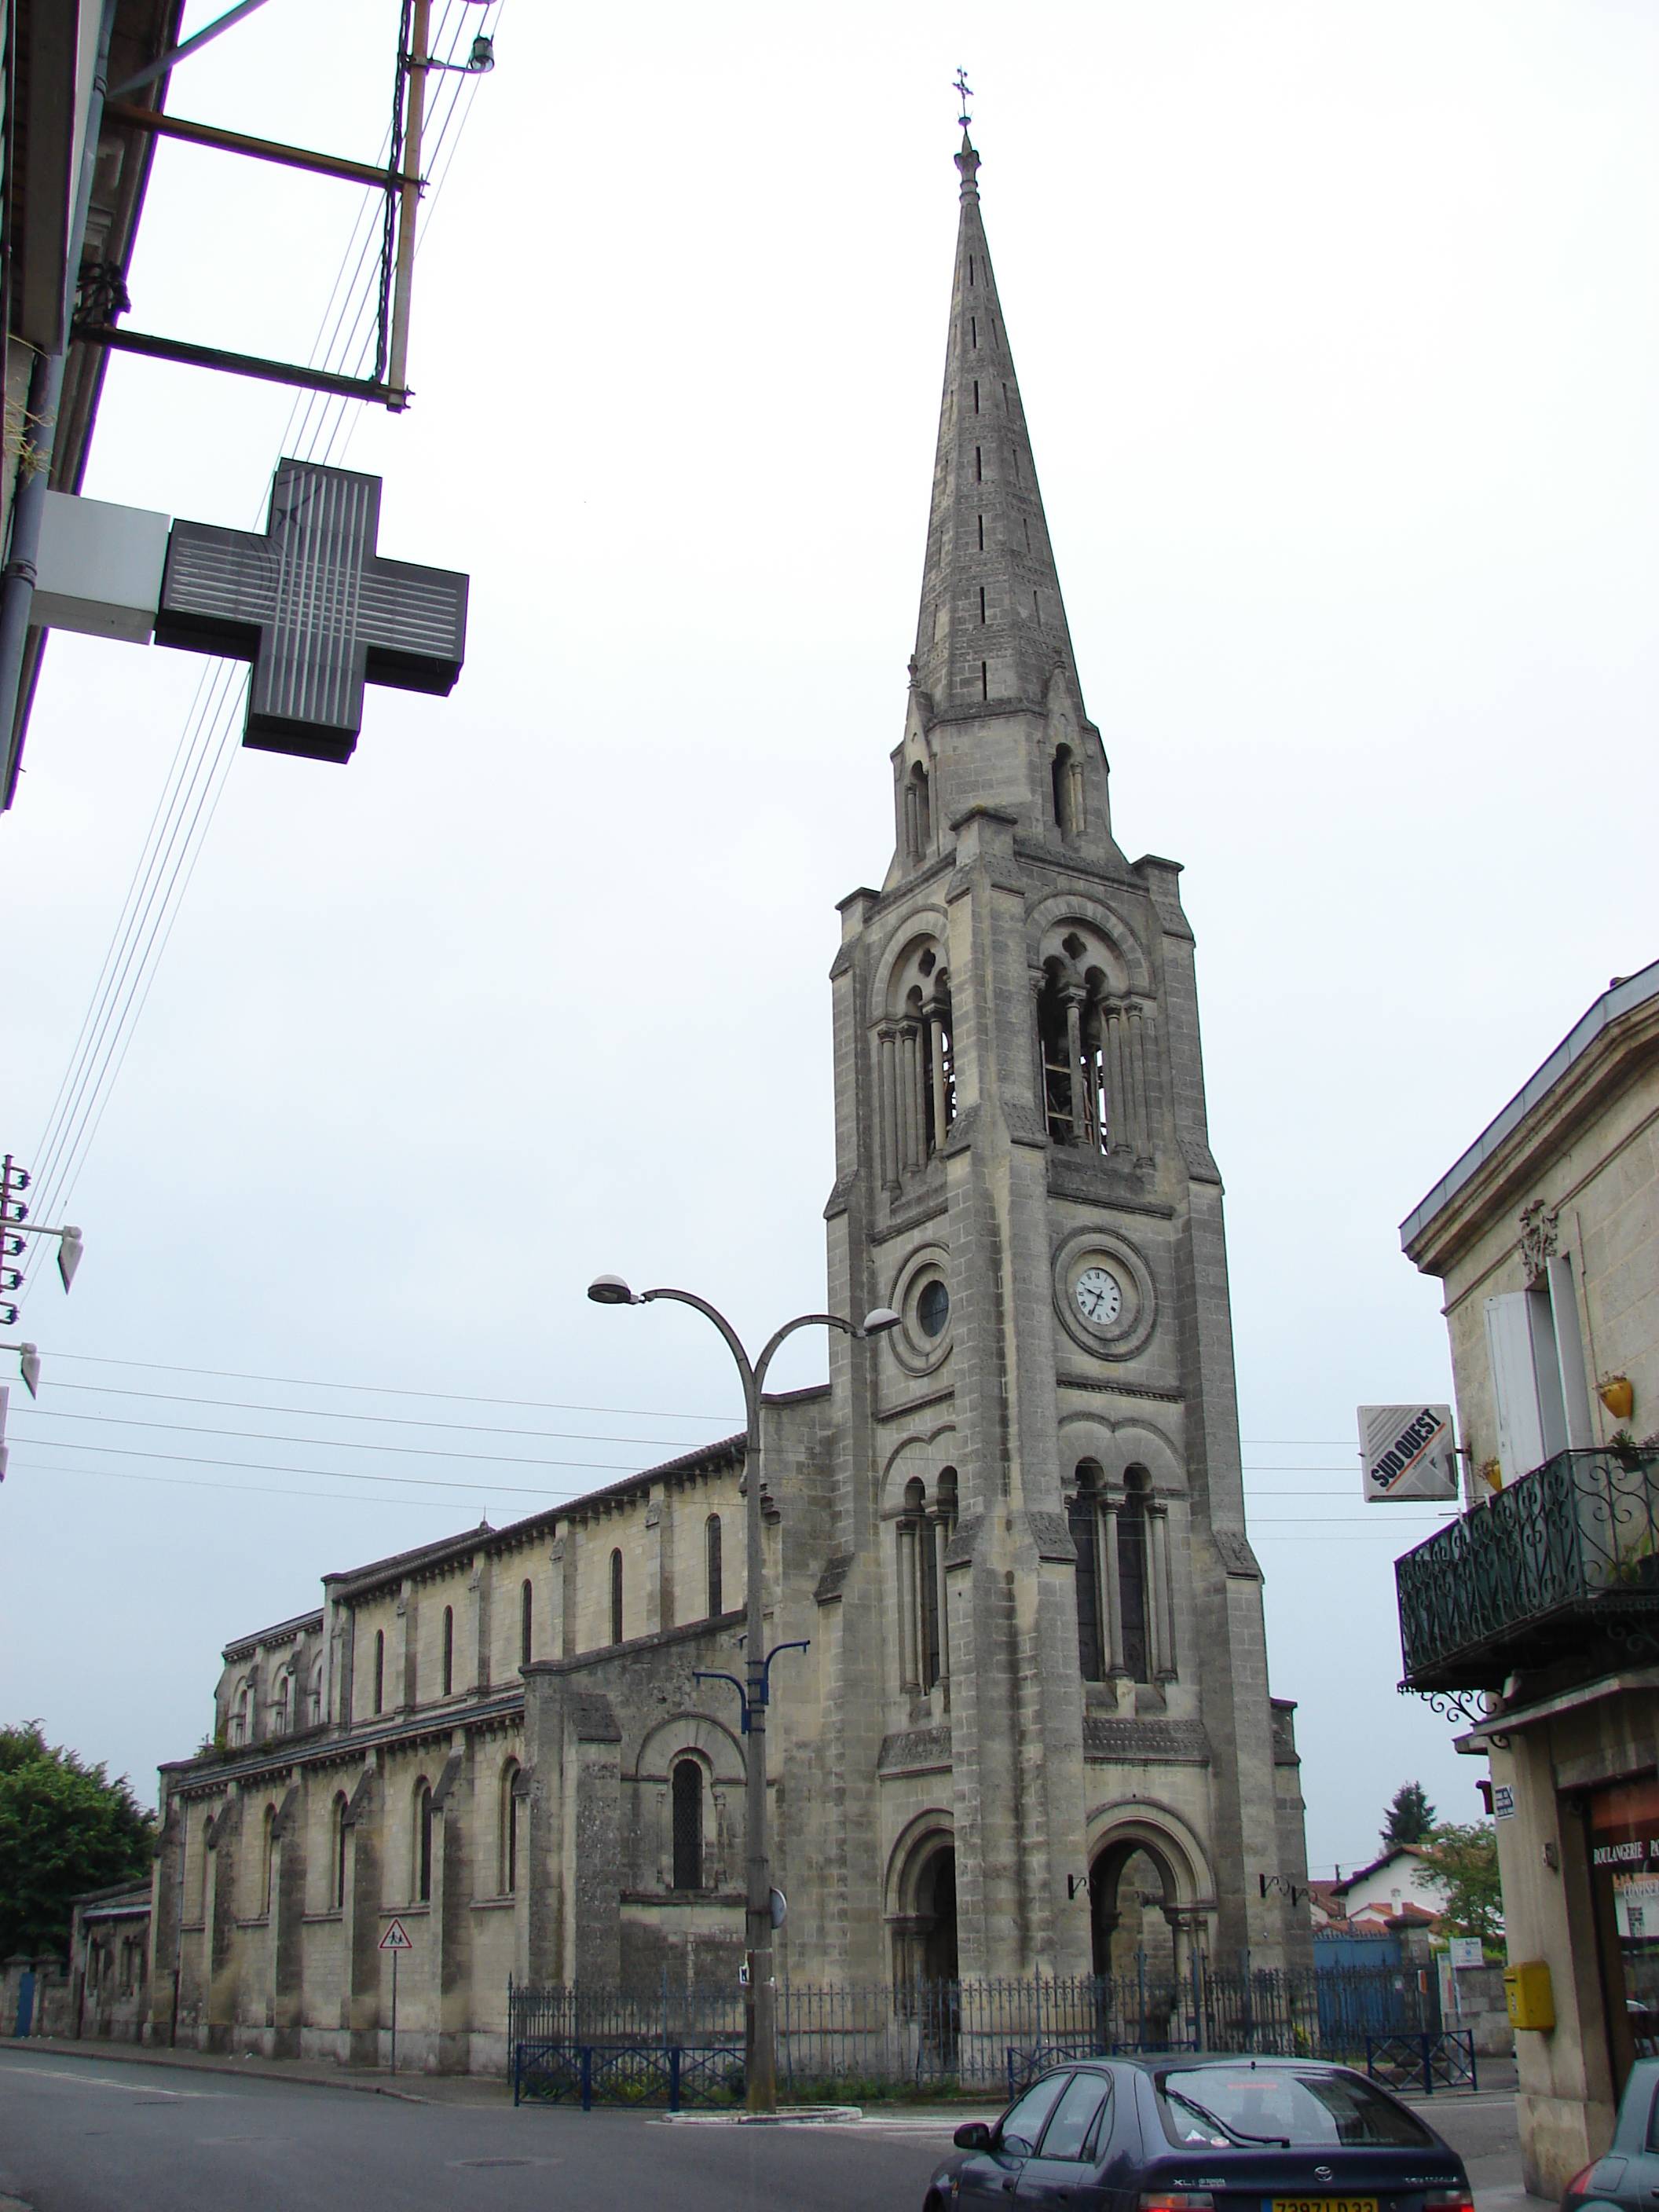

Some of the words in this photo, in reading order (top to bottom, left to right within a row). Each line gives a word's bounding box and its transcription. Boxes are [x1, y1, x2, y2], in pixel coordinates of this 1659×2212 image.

[1371, 1450, 1405, 1488] SUD
[1394, 1408, 1441, 1459] OUEST
[1594, 1842, 1643, 1864] BOULANGERIE
